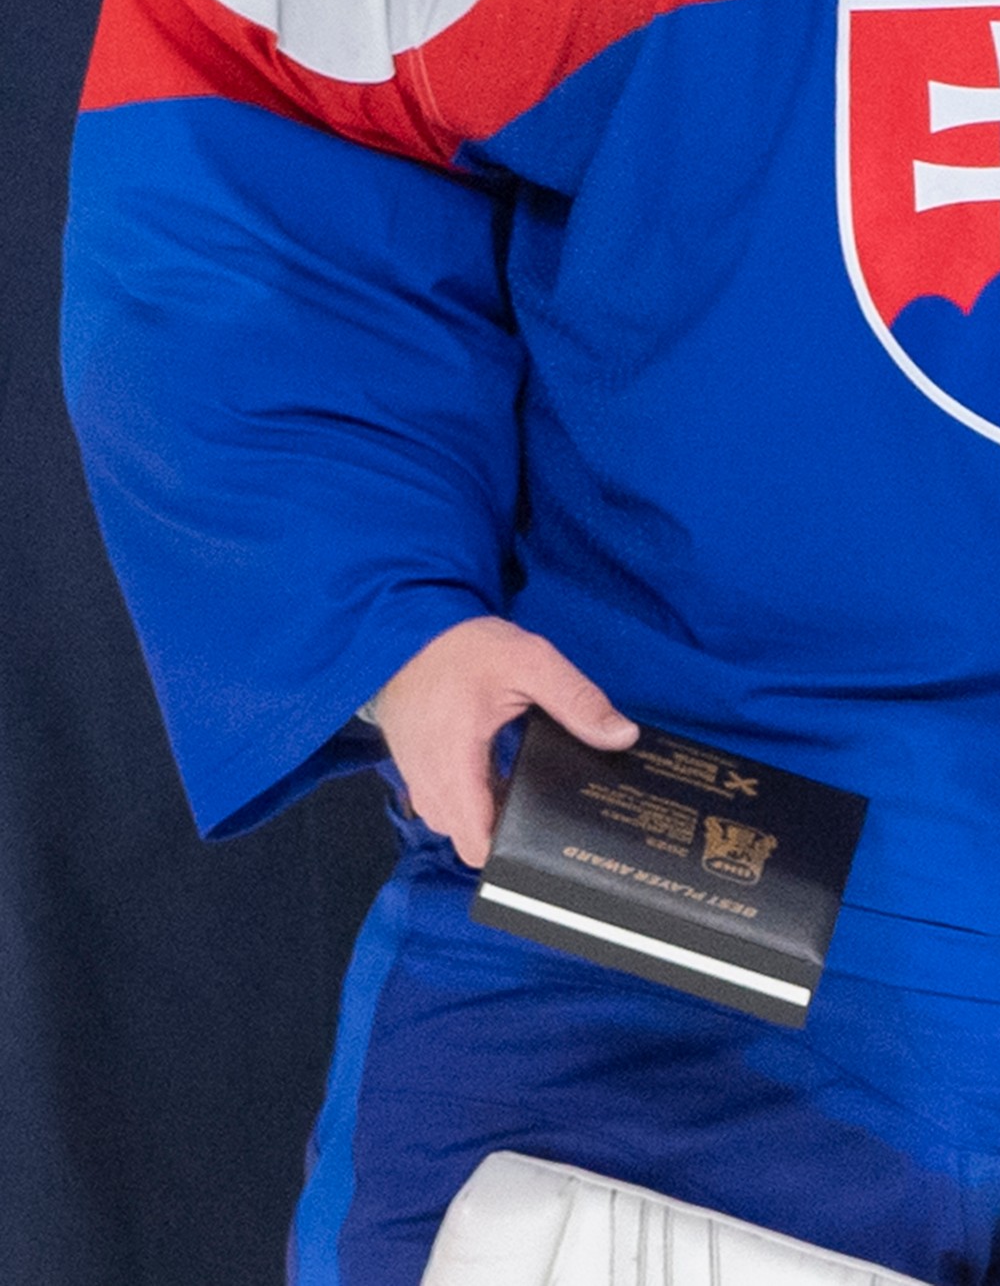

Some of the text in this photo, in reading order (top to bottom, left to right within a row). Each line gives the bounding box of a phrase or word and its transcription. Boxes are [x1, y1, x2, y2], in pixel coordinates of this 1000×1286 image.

[562, 845, 758, 919] BEST PLAYER AWARD
